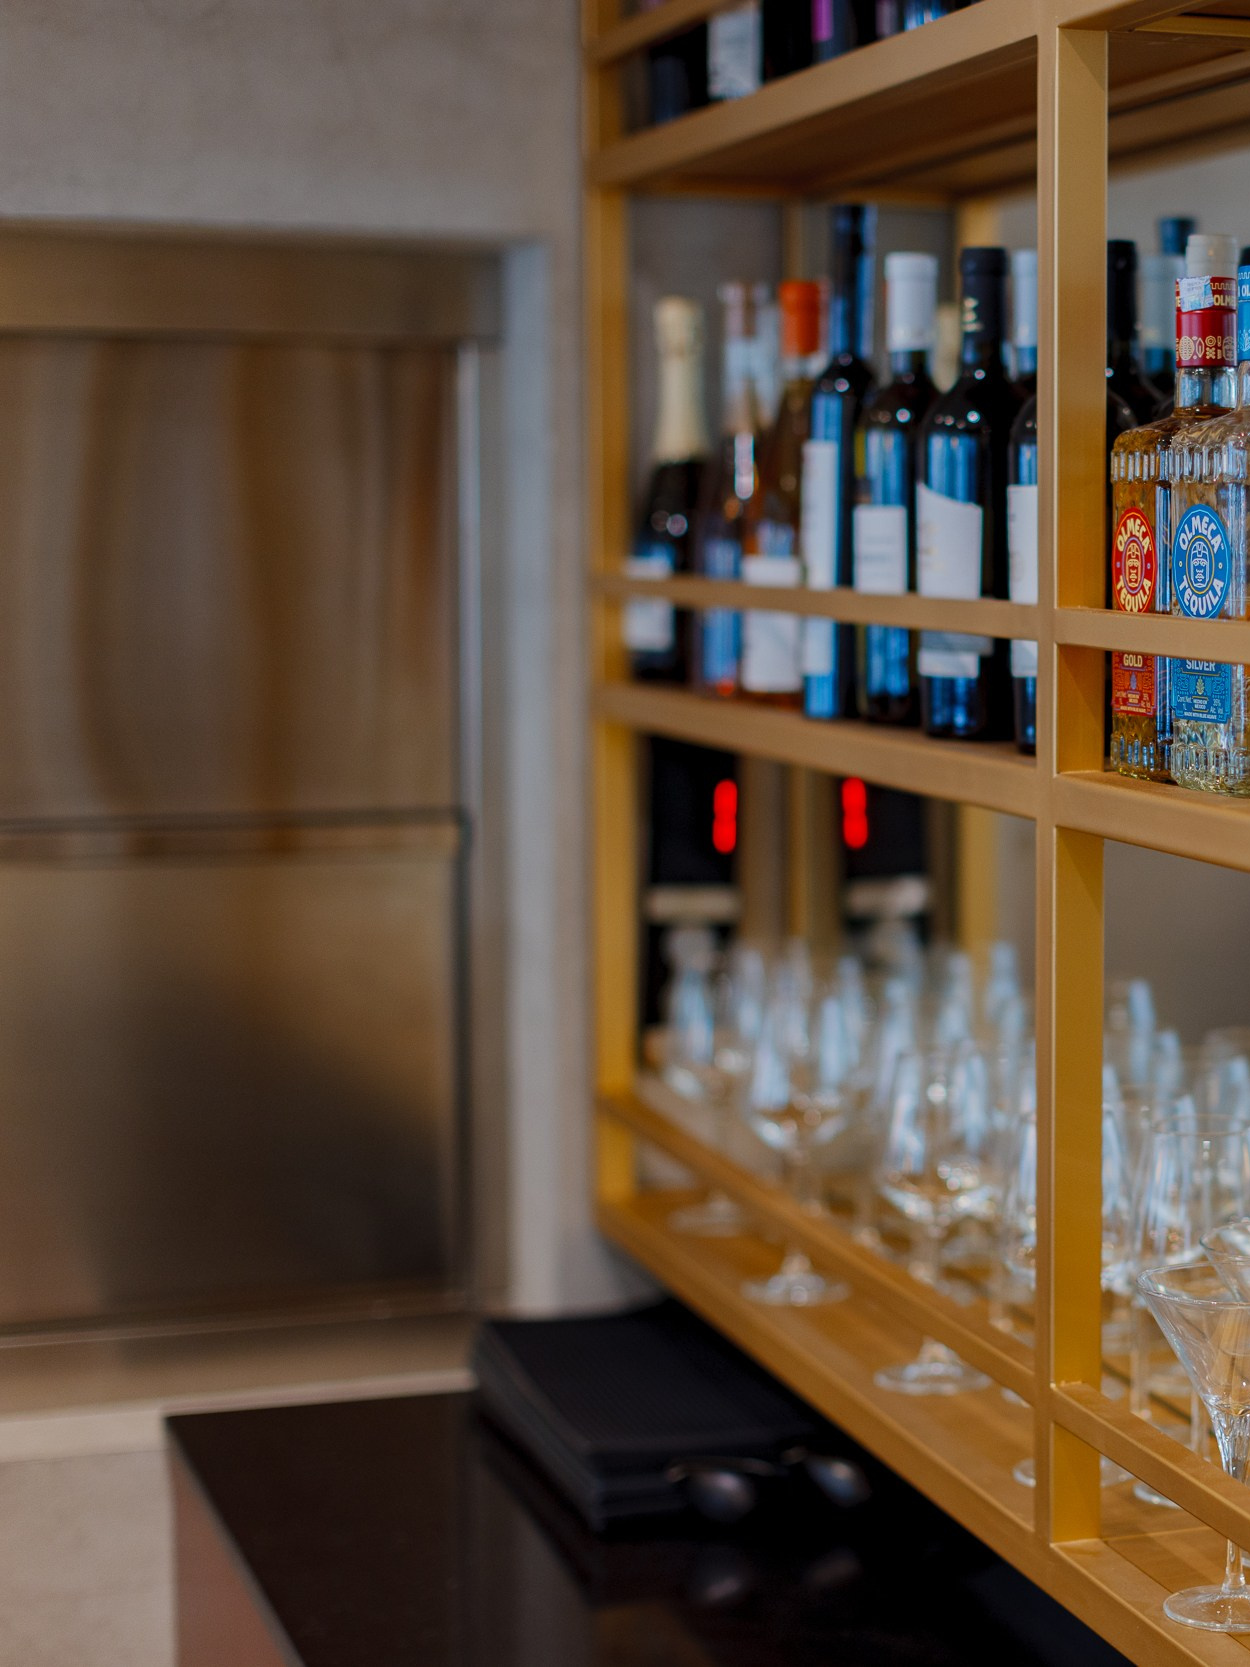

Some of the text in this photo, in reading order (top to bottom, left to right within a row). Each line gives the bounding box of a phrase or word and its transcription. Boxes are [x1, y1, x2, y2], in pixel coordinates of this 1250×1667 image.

[1116, 518, 1151, 555] OLMECA
[1179, 515, 1222, 554] OLMECA
[1116, 575, 1152, 613] TEQUILA
[1179, 575, 1224, 616] TEQUILA
[1123, 653, 1143, 667] GOLD
[1186, 659, 1216, 672] SILVER
